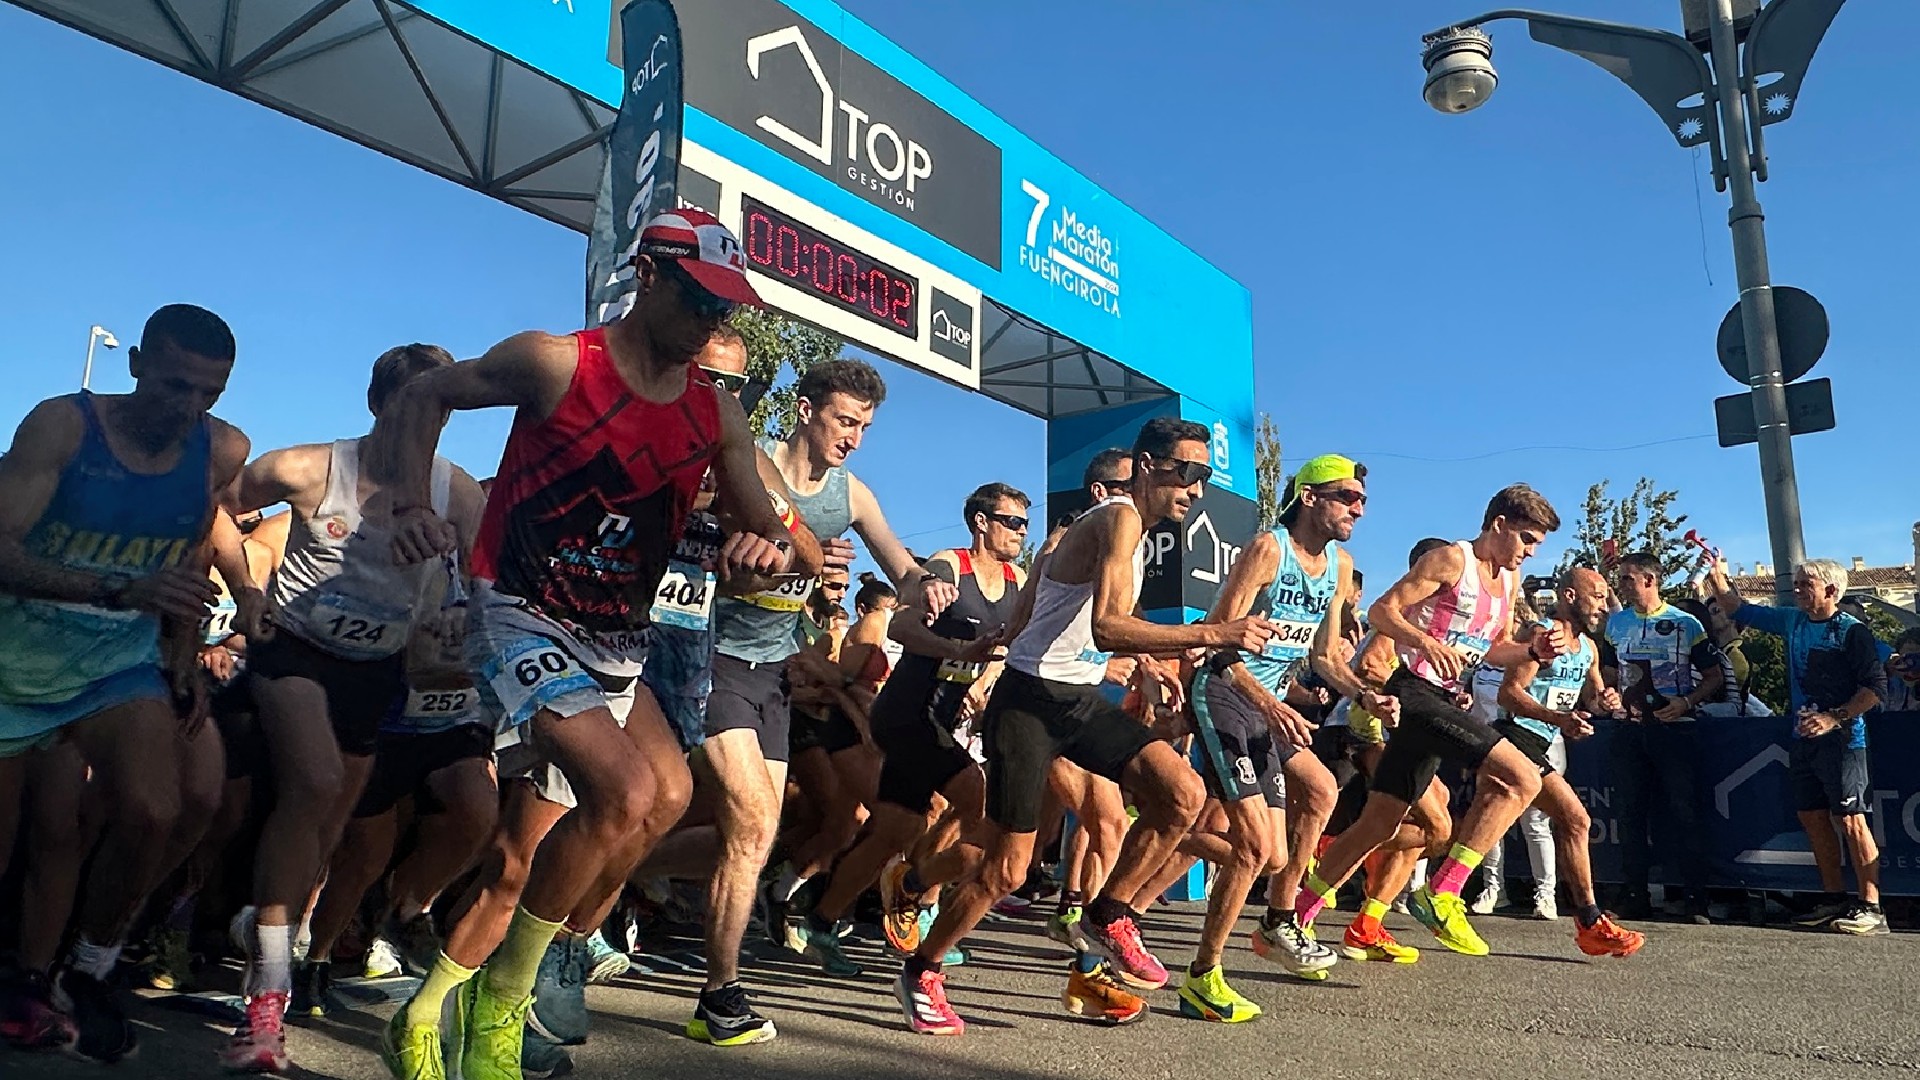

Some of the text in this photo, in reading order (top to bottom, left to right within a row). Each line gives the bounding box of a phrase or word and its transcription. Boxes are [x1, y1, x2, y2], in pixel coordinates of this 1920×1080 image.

[839, 99, 933, 193] TOP
[847, 166, 915, 212] GESTIÓN
[1022, 178, 1050, 248] 7
[1052, 219, 1119, 280] Maratón
[1061, 204, 1112, 256] Media
[749, 212, 912, 328] 00:00:02
[1020, 244, 1121, 319] FUENGIROLA
[951, 324, 971, 345] TOP
[658, 590, 708, 610] 404
[328, 614, 387, 645] 124
[421, 693, 467, 713] 252
